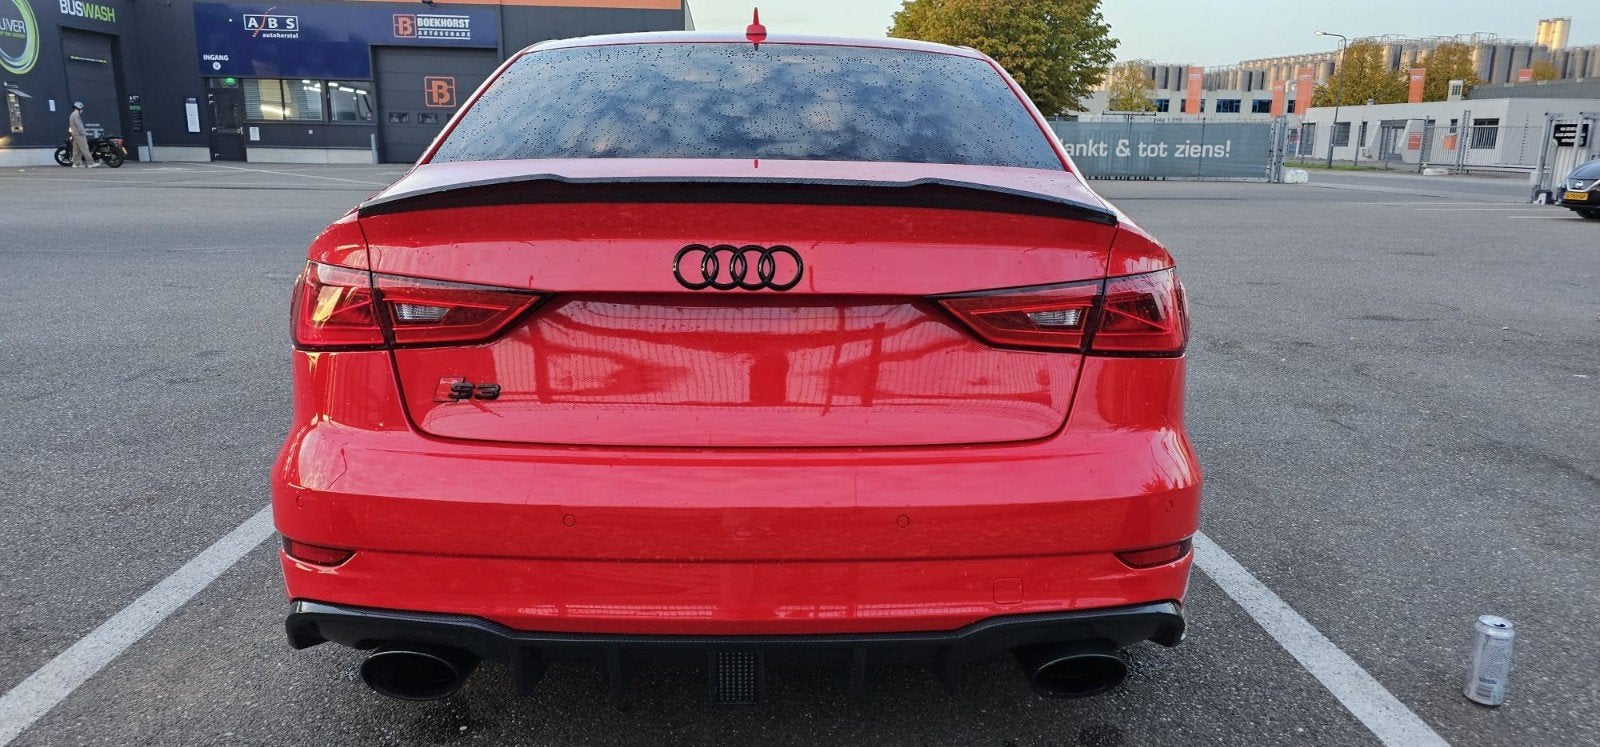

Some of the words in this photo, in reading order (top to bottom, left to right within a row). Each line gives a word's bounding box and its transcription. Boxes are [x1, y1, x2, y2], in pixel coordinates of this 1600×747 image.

[59, 0, 116, 22] BUSWASH
[247, 17, 295, 29] ABS
[417, 17, 470, 28] BOEKHORST
[1059, 139, 1108, 157] ankt
[1115, 139, 1131, 157] &
[1138, 141, 1168, 158] tot
[1174, 140, 1231, 158] ziens!
[448, 382, 501, 400] S3
